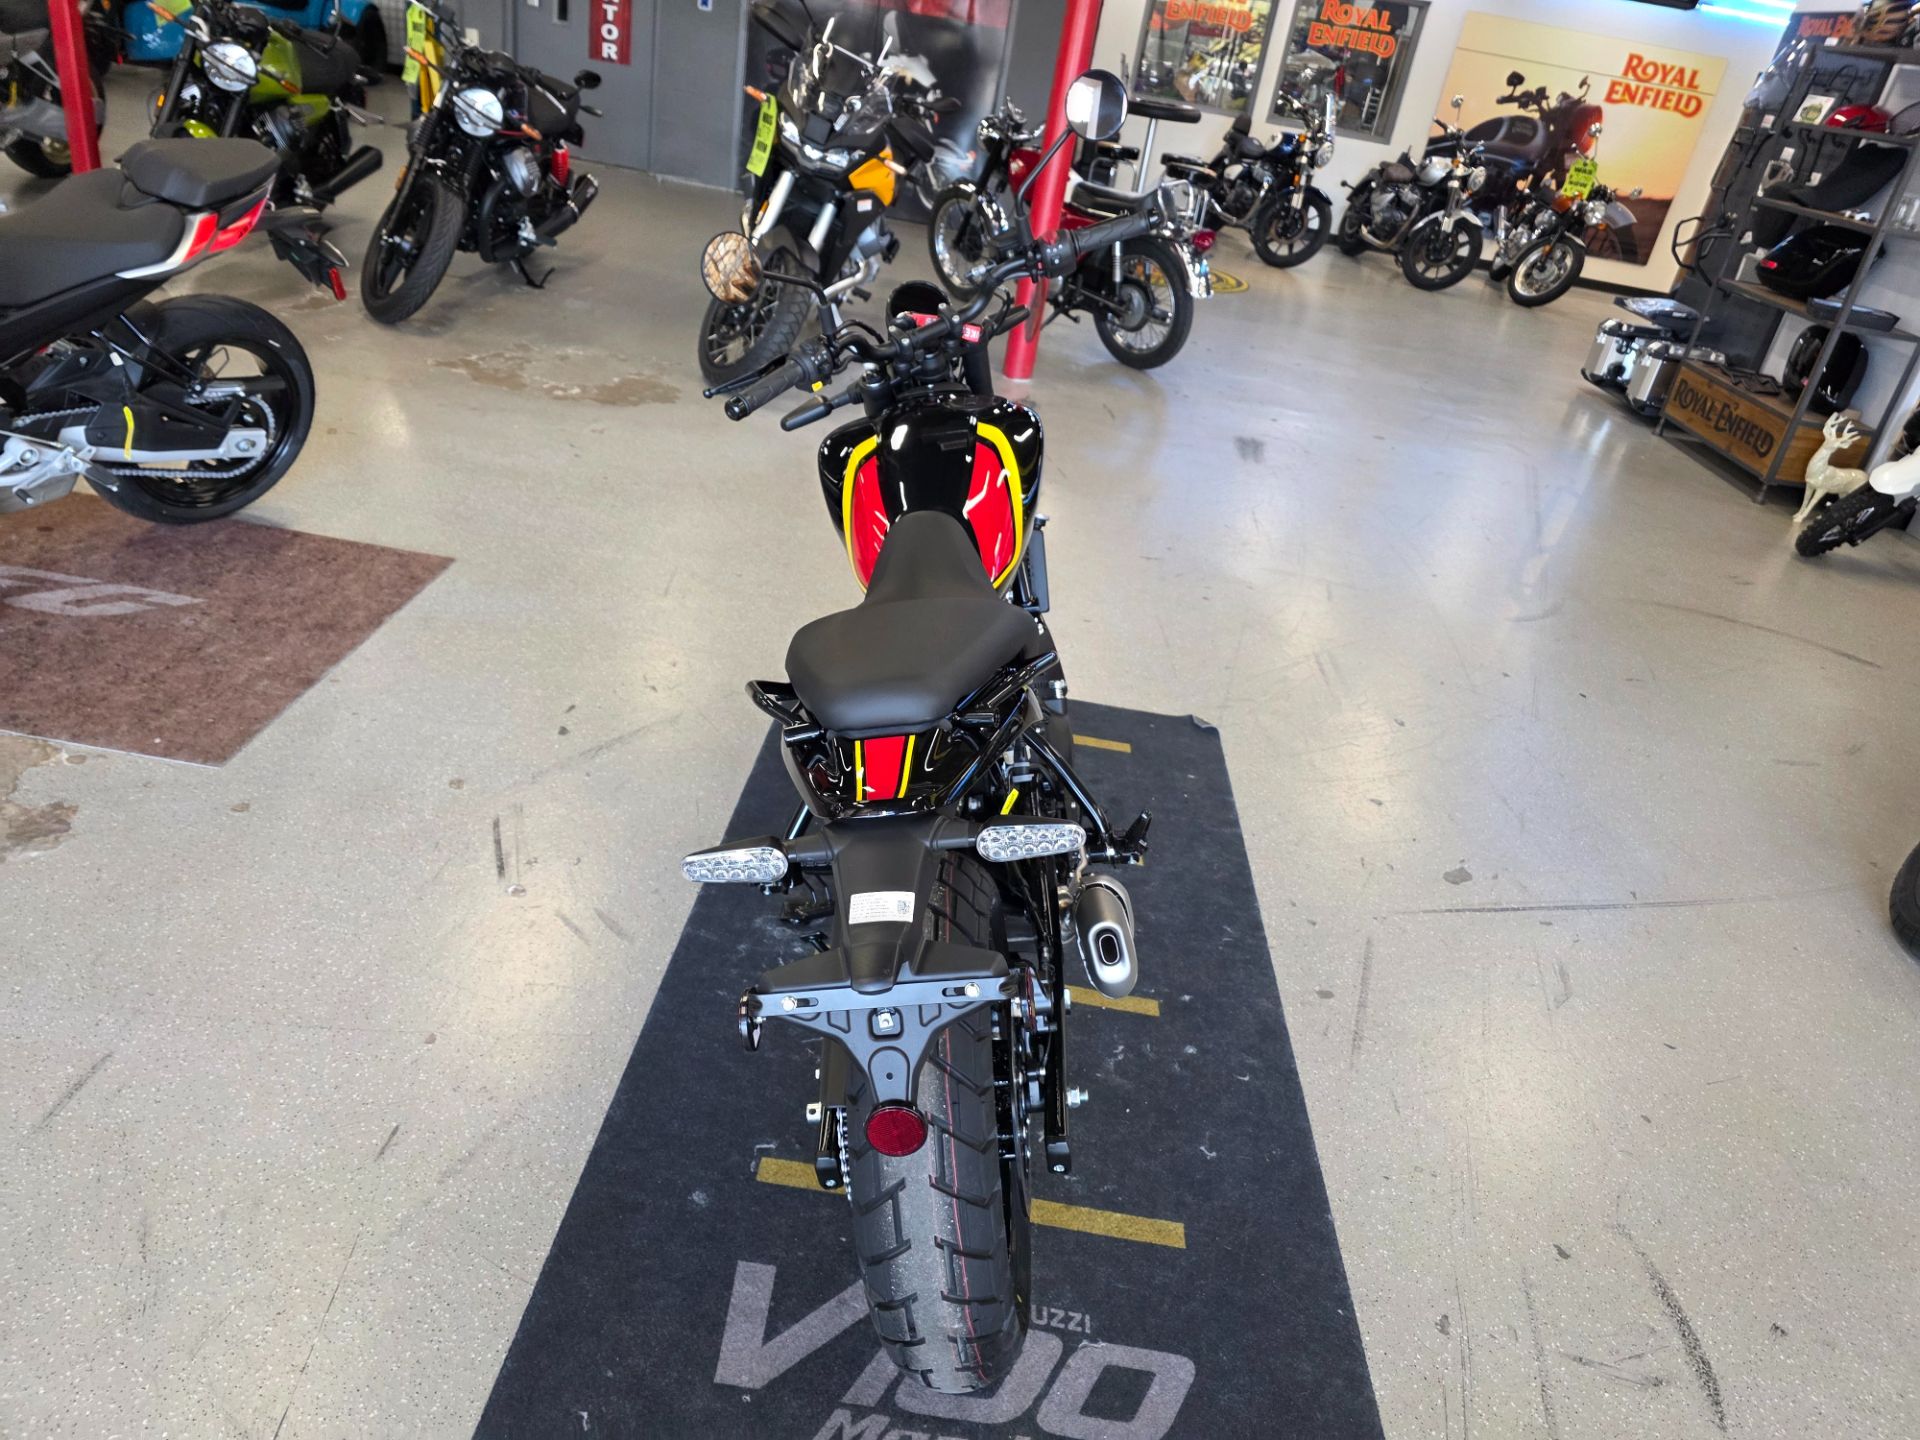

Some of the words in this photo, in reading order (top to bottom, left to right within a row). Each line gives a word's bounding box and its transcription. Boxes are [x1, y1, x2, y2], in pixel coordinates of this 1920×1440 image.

[601, 0, 619, 61] TOR
[1164, 0, 1253, 33] ENFIELD
[1320, 0, 1392, 32] ROYAL
[1306, 21, 1396, 58] ENFIELD
[1622, 52, 1700, 90] ROYAL
[1603, 79, 1703, 118] ENFIELD
[1673, 378, 1714, 422] ROYAL
[1713, 401, 1775, 458] ENFIELD
[1030, 1304, 1091, 1334] UZZI
